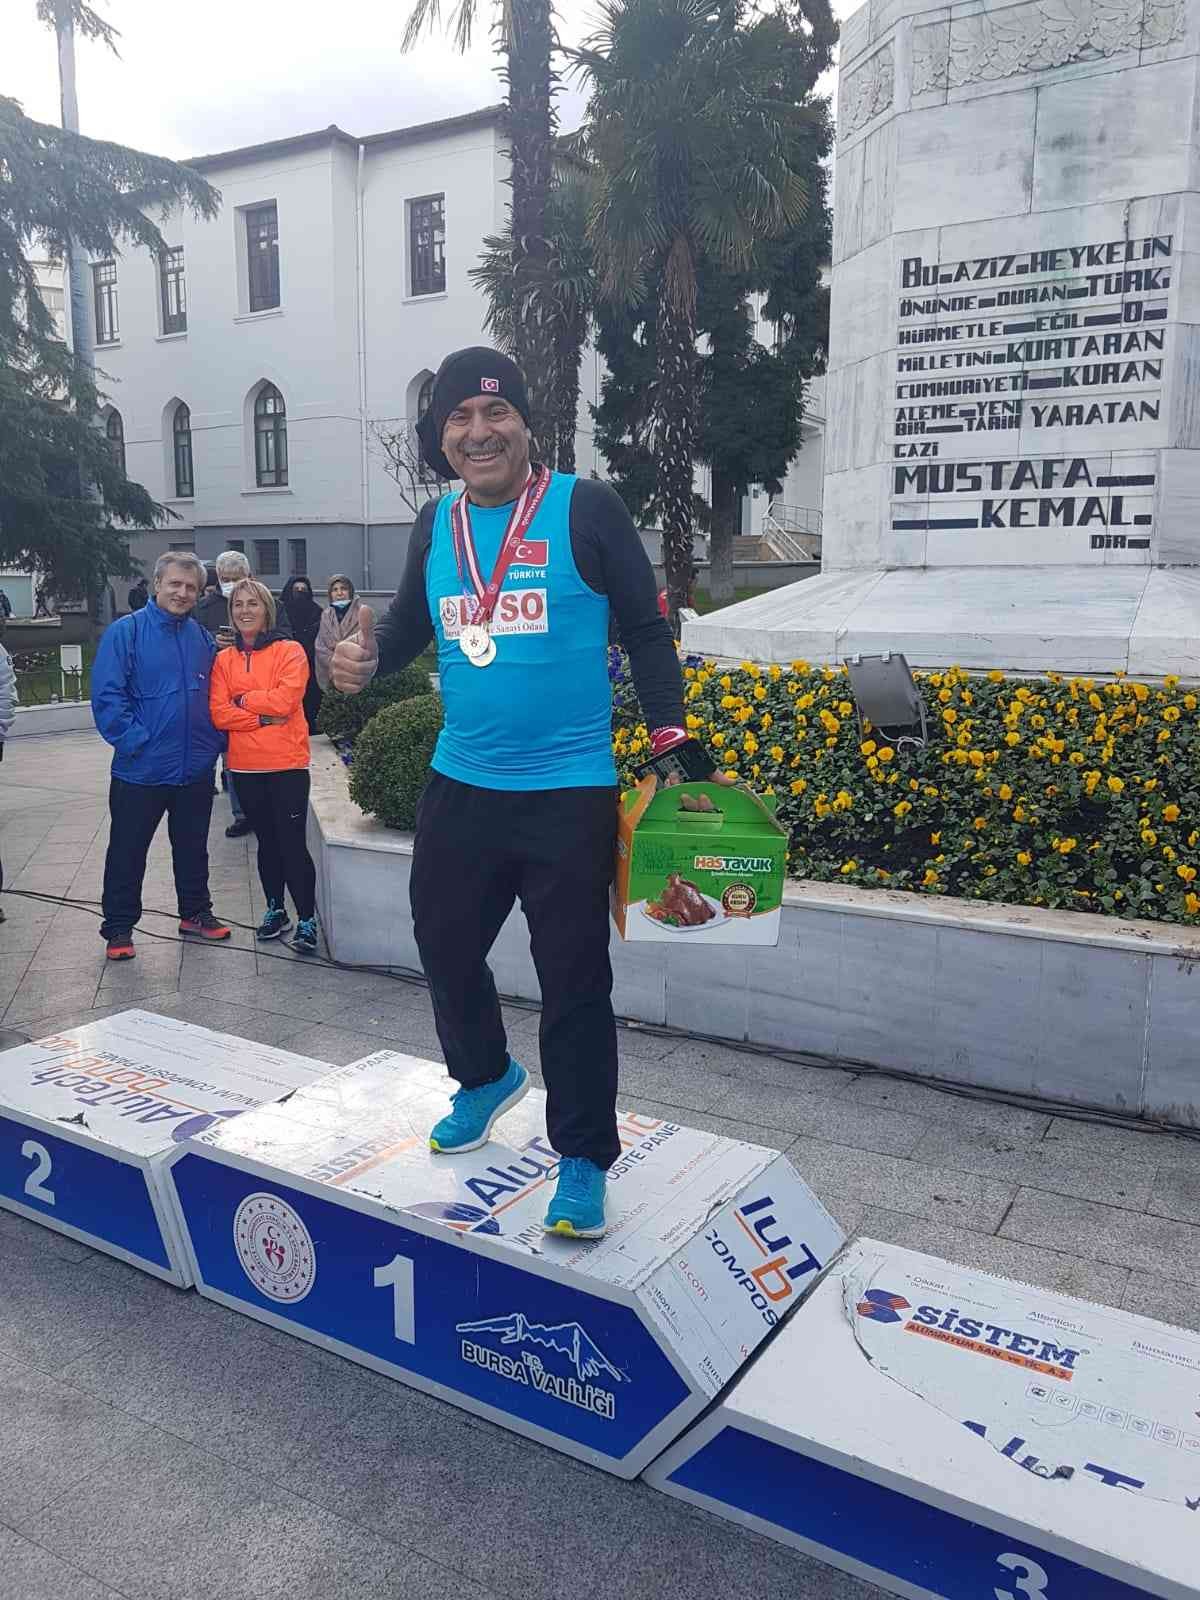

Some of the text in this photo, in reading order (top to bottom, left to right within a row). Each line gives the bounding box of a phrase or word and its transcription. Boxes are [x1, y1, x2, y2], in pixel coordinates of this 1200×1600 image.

[997, 285, 1066, 306] DURAN
[899, 322, 1004, 345] HÜRMETLE
[1007, 329, 1164, 363] KURTARAN
[1063, 359, 1162, 387] KURAN
[1031, 400, 1160, 428] YARATAN
[894, 458, 1093, 494] MUSTAFA
[981, 496, 1132, 528] KEMAL
[509, 569, 547, 580] TÜRKİYE
[21, 1140, 55, 1205] 2
[373, 1254, 416, 1345] 1
[912, 1304, 1080, 1370] SİSTEM
[462, 1339, 616, 1420] BURSA VALİLİĞİ
[994, 1552, 1050, 1600] 3
